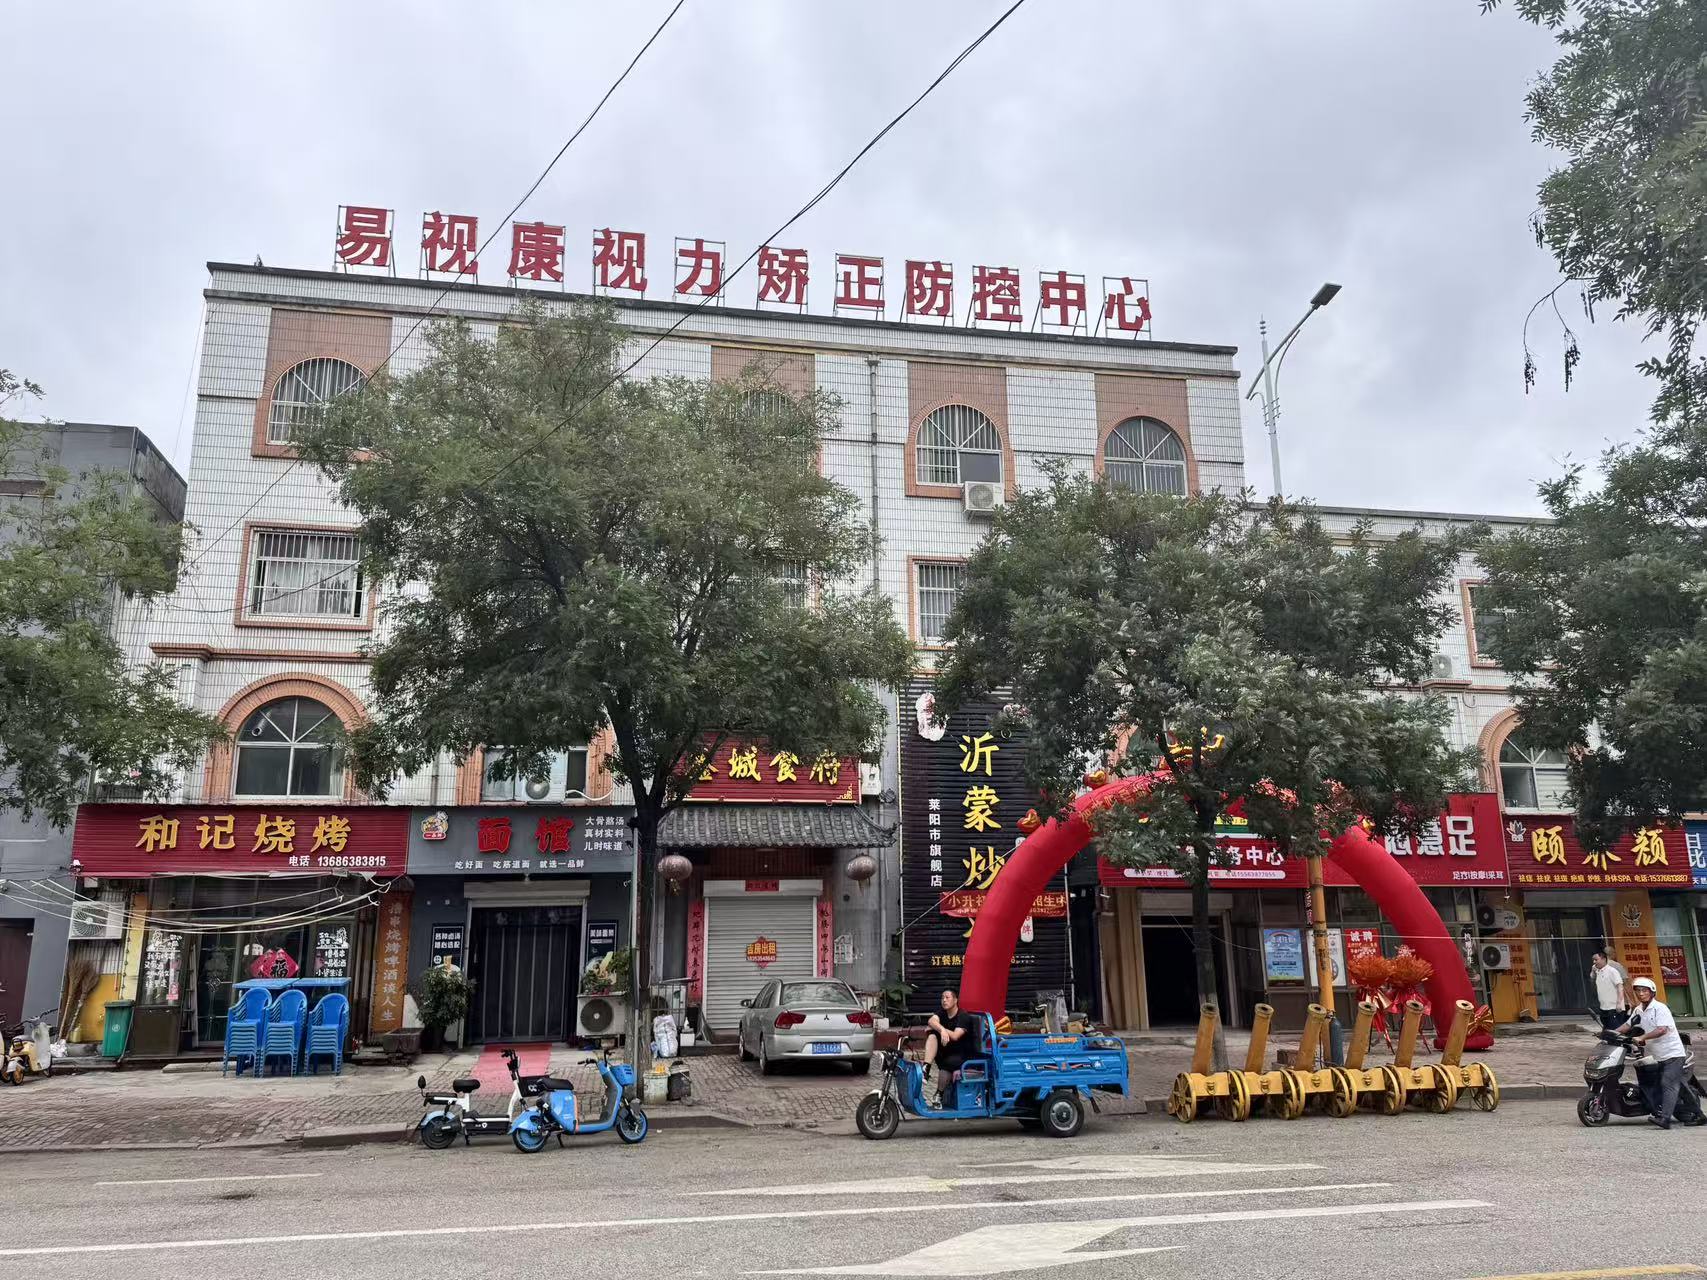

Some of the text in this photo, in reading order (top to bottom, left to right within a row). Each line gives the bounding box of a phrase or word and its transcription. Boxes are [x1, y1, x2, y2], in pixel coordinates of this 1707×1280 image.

[336, 206, 1151, 331] 易视康视力矫正防控中心
[585, 816, 625, 826] 大骨熬汤
[135, 814, 351, 853] 和记烧烤
[477, 816, 575, 853] 面馆
[584, 828, 624, 838] 真材实料
[959, 731, 1004, 938] 沂蒙炒
[584, 841, 623, 851] 儿时味道
[928, 799, 943, 887] 莱阳市旗舰店
[289, 856, 386, 867] 电话 13686383815
[454, 861, 483, 869] 吃好面
[539, 859, 585, 868] 就选一品鲜
[746, 942, 776, 955] 吉房出租
[931, 955, 965, 966] 订餐热
